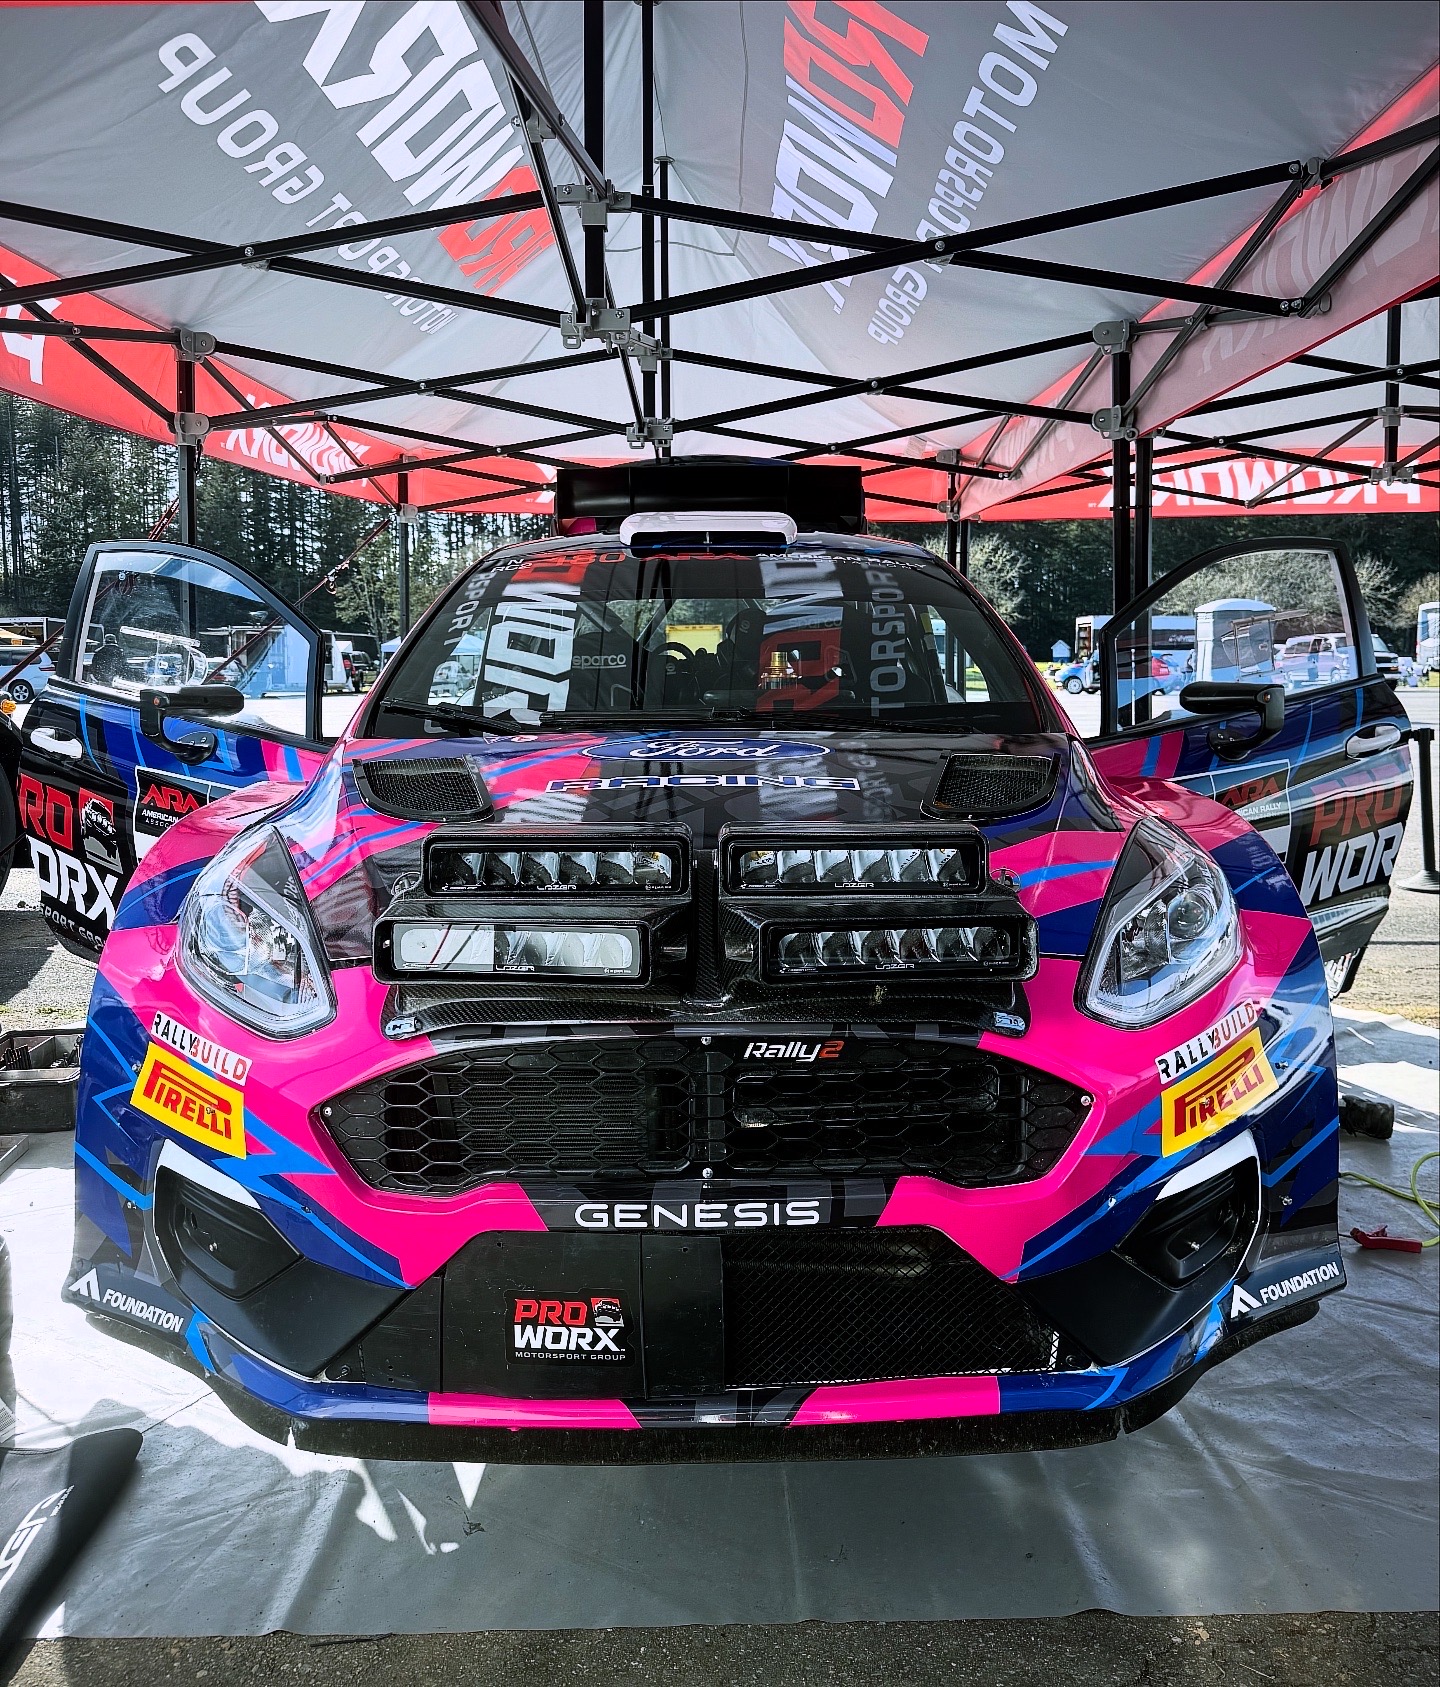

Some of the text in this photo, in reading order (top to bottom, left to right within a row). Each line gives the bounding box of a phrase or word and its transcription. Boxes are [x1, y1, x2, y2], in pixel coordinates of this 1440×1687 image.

[572, 653, 627, 667] sparco
[629, 739, 780, 758] Ford
[545, 774, 861, 792] RACING
[1221, 776, 1280, 807] ARA
[140, 783, 200, 814] ARA
[1309, 762, 1403, 847] PRO
[141, 809, 179, 823] AMERICAN
[1300, 821, 1404, 906] WOR
[743, 1040, 845, 1062] Rally2
[142, 1059, 232, 1140] PIRELLI
[1174, 1046, 1265, 1137] PIRELLI
[574, 1200, 820, 1229] GENESIS
[1259, 1261, 1341, 1304] FOUNDATION
[102, 1288, 185, 1333] FOUNDATION
[513, 1298, 588, 1326] PRO
[513, 1324, 622, 1352] WORX
[515, 1351, 587, 1360] MOTORSPORT
